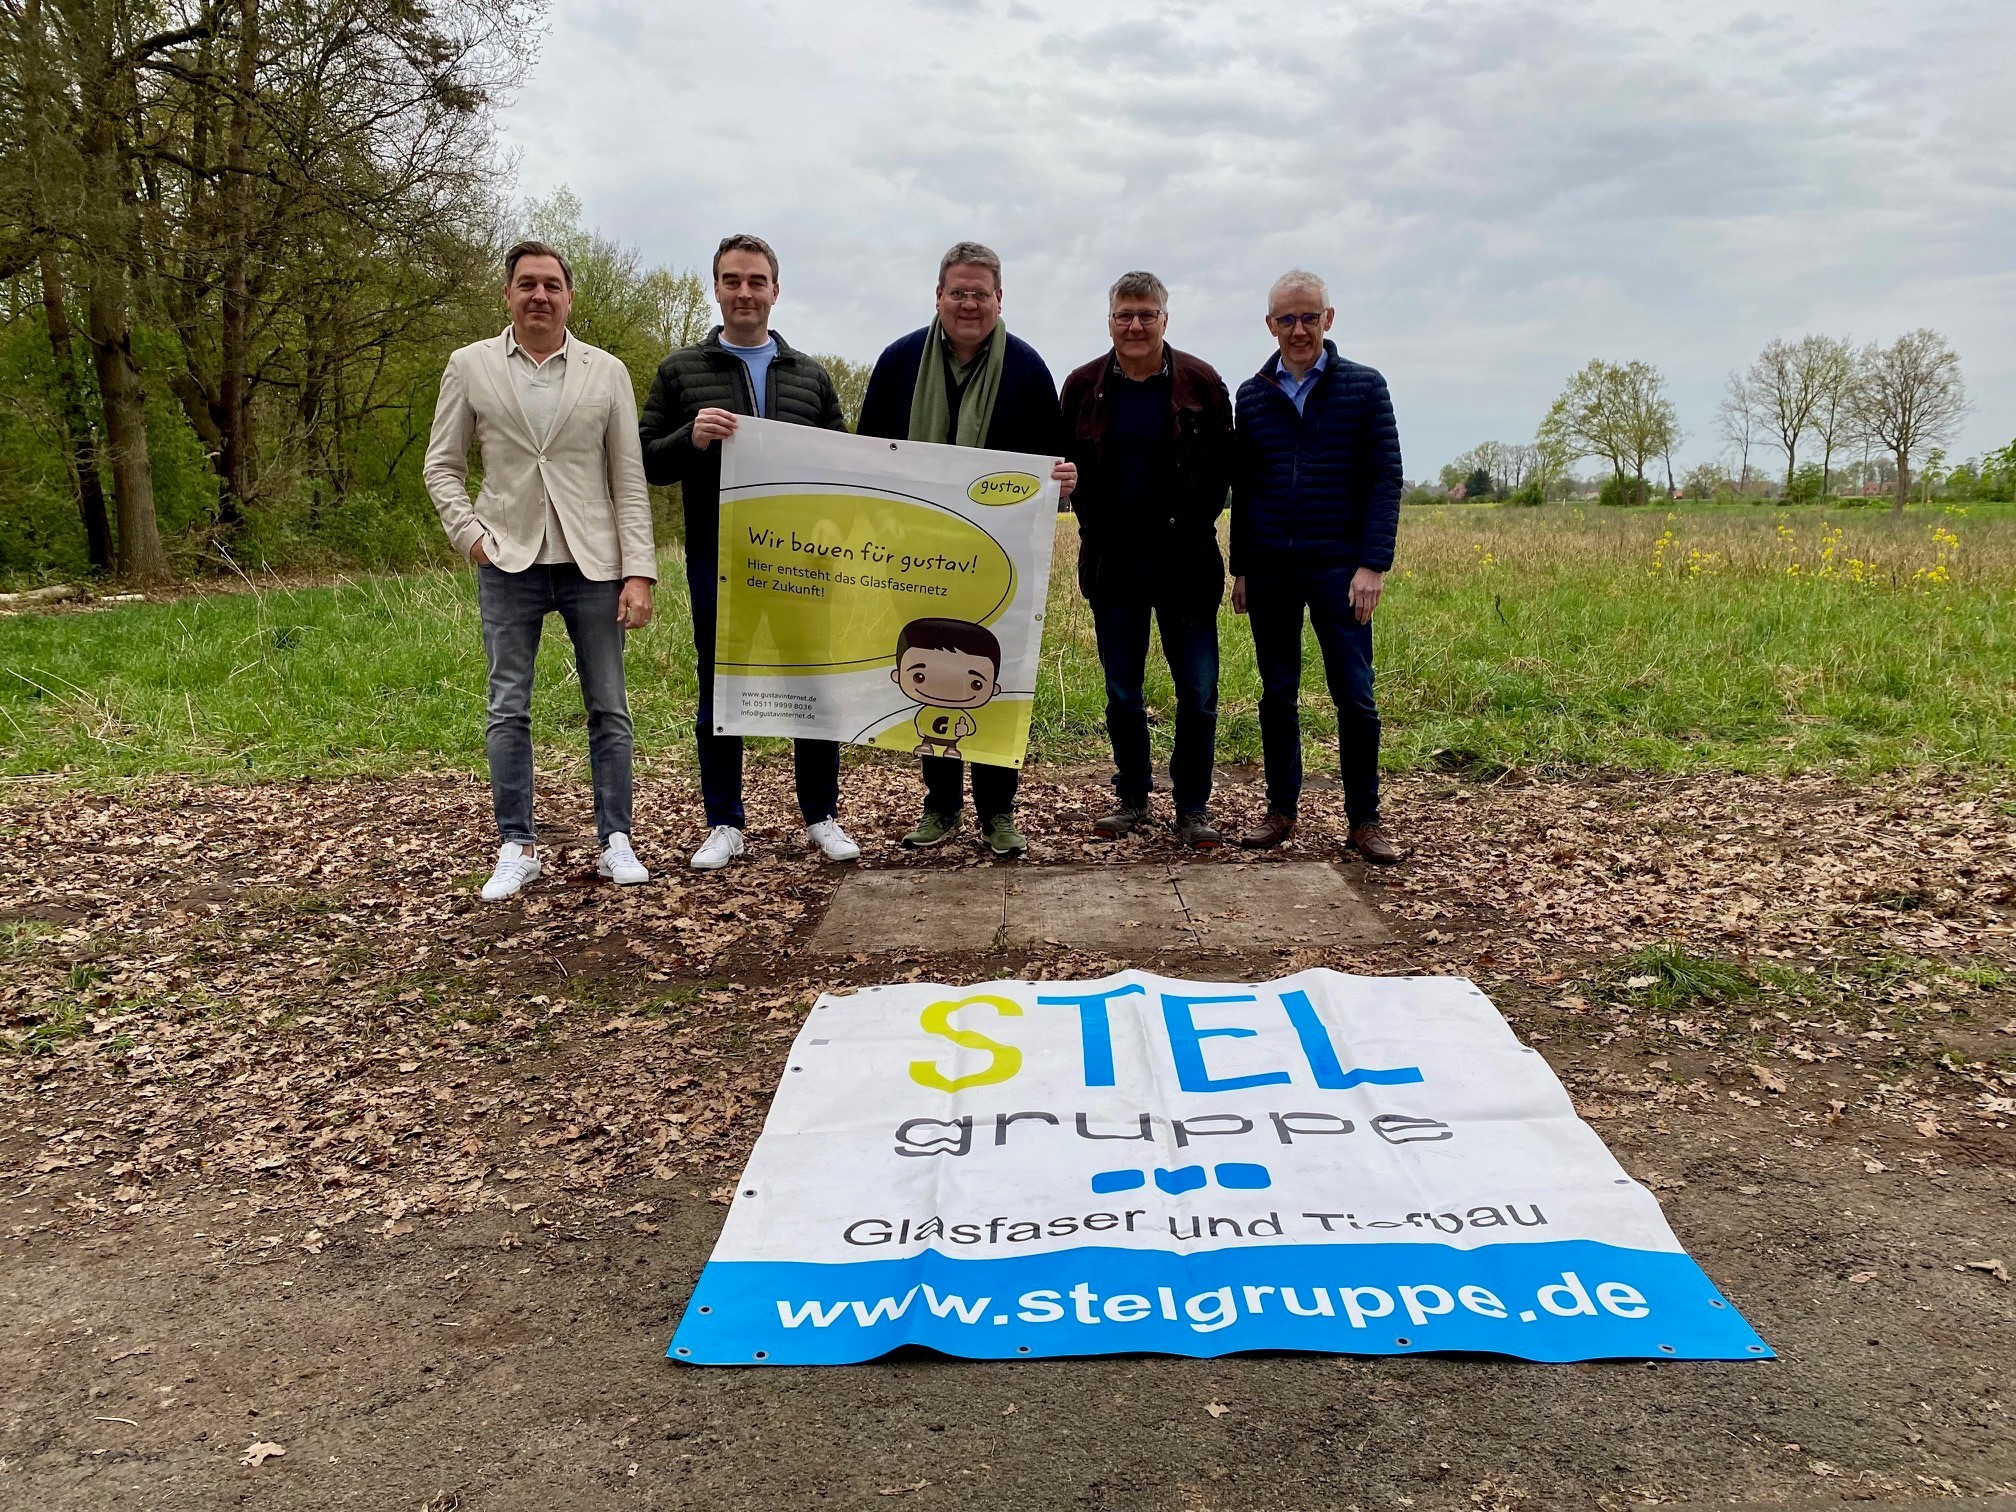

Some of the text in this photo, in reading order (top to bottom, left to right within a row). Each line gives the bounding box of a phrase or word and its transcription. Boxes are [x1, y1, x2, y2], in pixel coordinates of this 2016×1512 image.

[980, 480, 1030, 495] gustav
[748, 527, 979, 574] Wir bauen für gustav!
[746, 576, 825, 598] der Zukunft!
[747, 558, 948, 597] Hier entsteht das Glasfasernetz
[741, 710, 816, 719] info@gustavinternet.de
[774, 701, 792, 709] 9999
[932, 716, 949, 735] G
[908, 983, 1425, 1094] STEL
[894, 1111, 1454, 1157] gruppe
[843, 1208, 1147, 1246] Glasfaser
[1168, 1211, 1285, 1241] und
[776, 1271, 1651, 1333] www.stelgruppe.de
